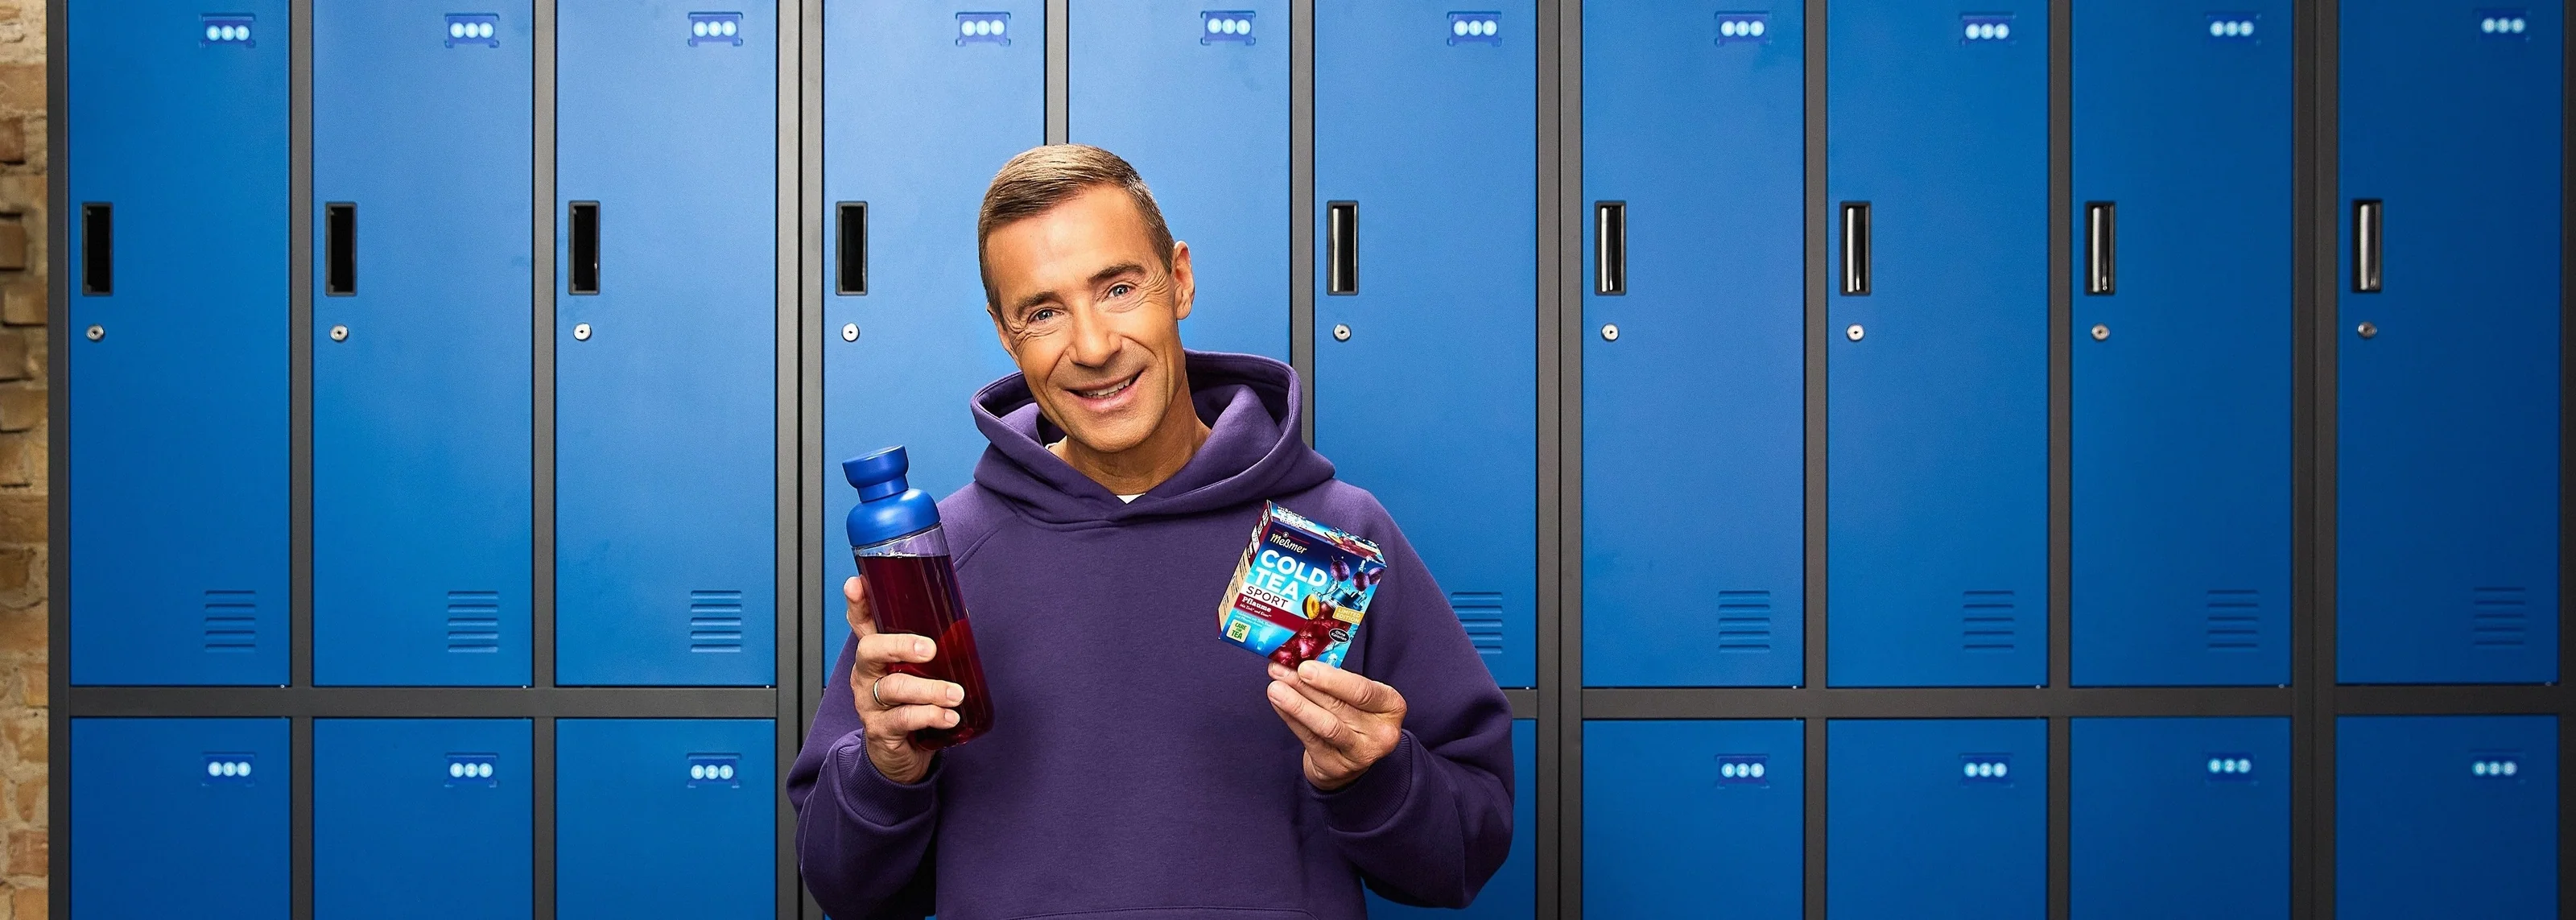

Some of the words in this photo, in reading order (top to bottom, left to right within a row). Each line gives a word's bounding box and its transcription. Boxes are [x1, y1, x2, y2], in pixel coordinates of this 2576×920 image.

[1269, 533, 1307, 554] Meßmer
[1261, 549, 1327, 587] COLD
[1256, 566, 1298, 600] TEA
[1246, 585, 1289, 608] SPORT
[1241, 596, 1272, 613] Pflaume
[1335, 613, 1360, 624] EDITION
[1338, 608, 1361, 618] LIMITED
[1235, 622, 1248, 631] CARE
[1335, 629, 1346, 637] Ohne
[1231, 629, 1243, 640] TEA
[691, 765, 733, 778] 021
